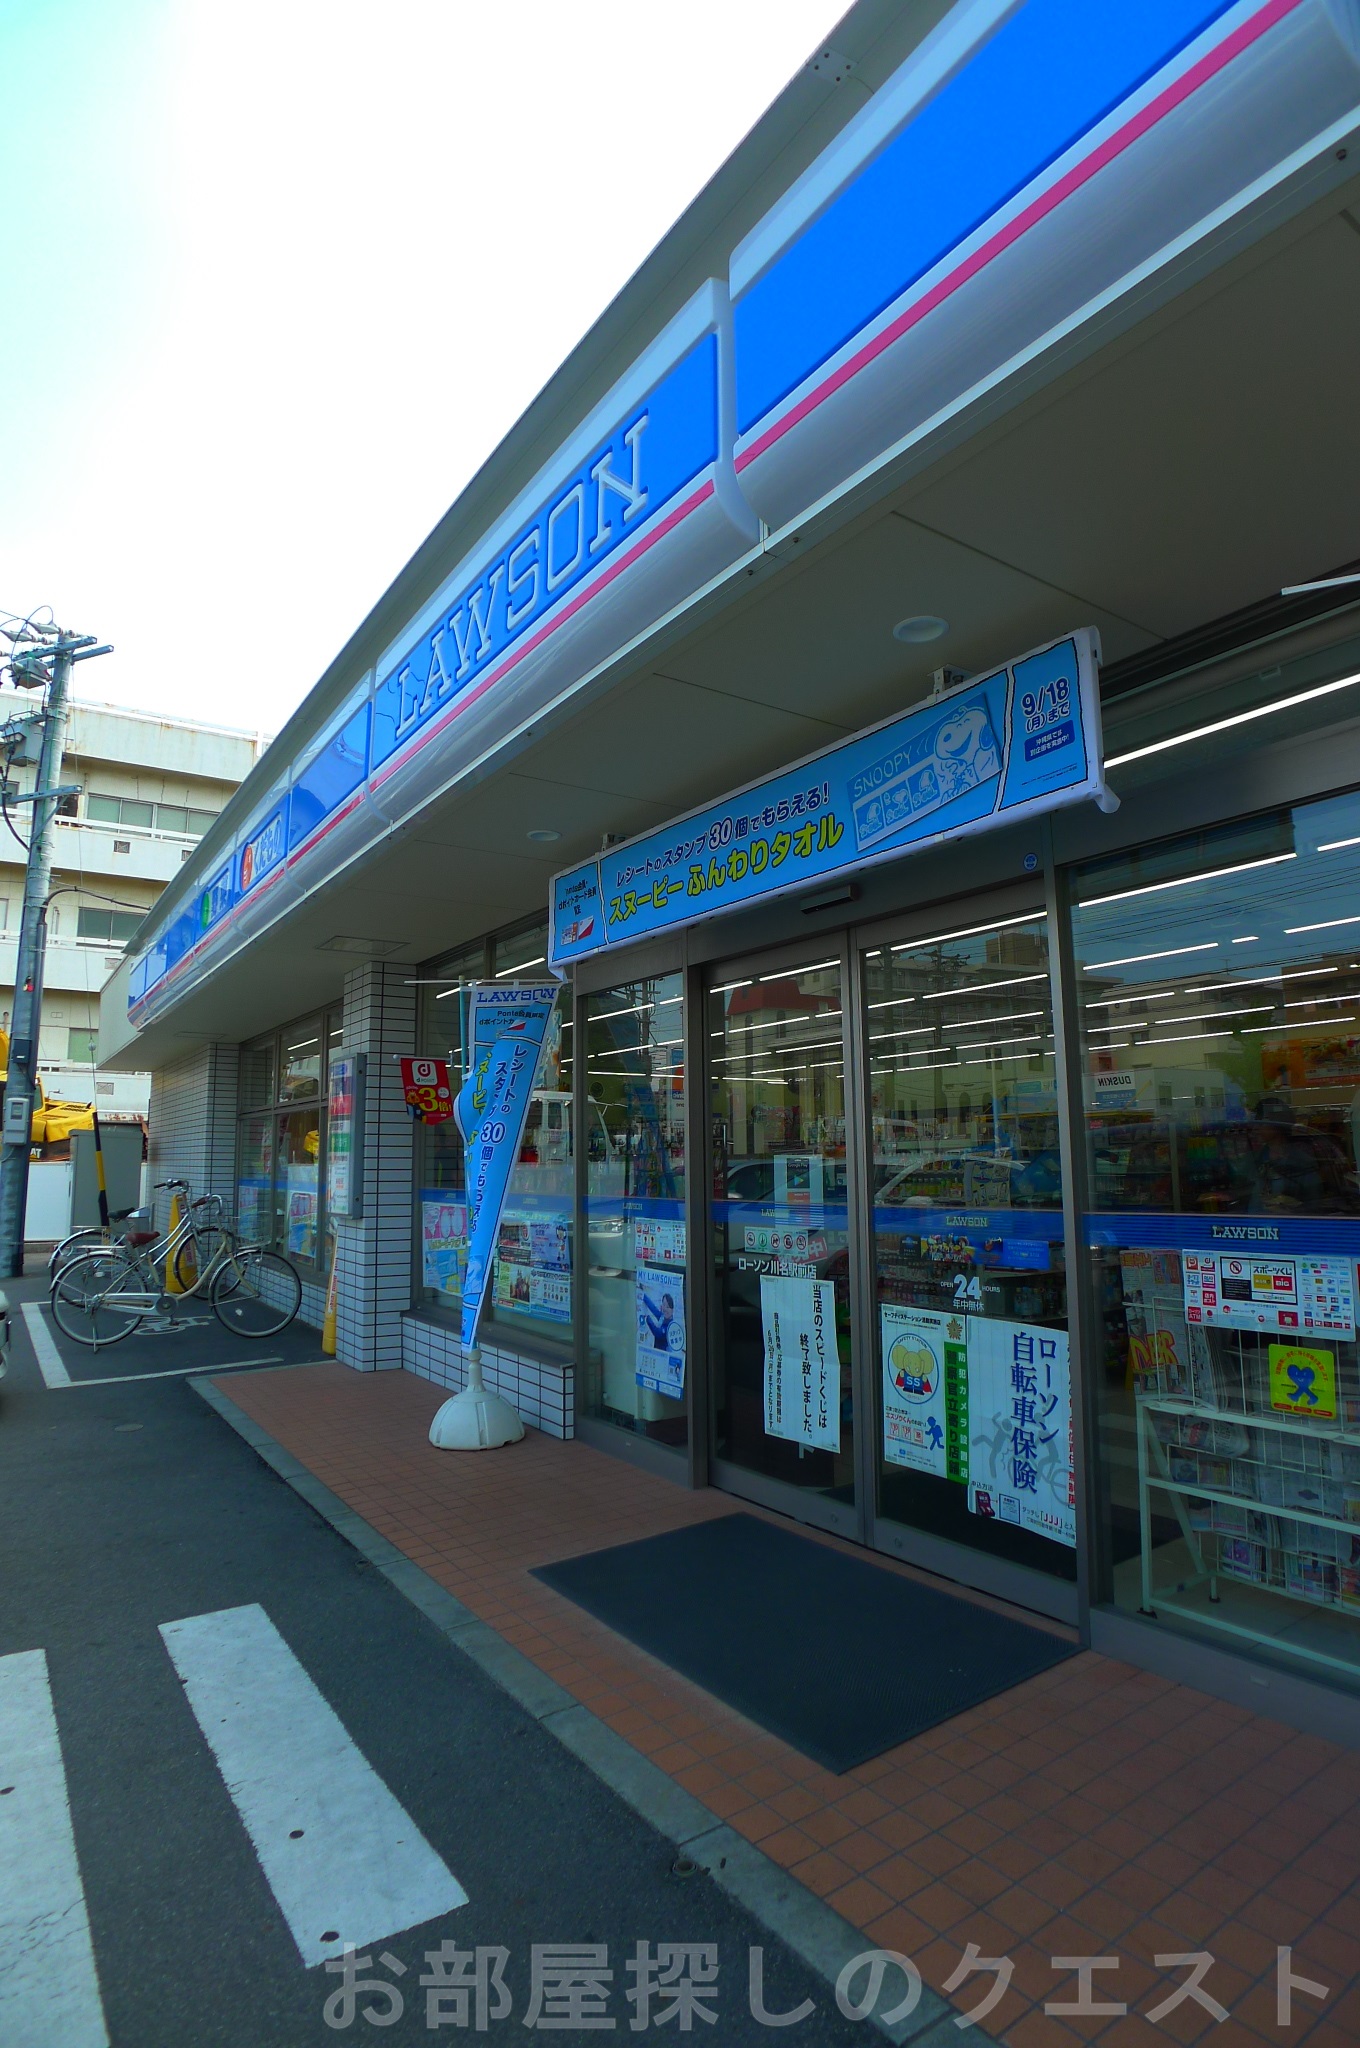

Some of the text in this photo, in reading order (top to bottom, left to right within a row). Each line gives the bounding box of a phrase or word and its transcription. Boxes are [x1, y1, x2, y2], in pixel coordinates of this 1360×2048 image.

[395, 413, 648, 738] LAWSON
[1022, 678, 1069, 716] 9/18
[1027, 702, 1070, 732] (月)まで
[855, 746, 911, 798] SNOOPY
[616, 782, 829, 887] レシートのスタンプ30個でもらえる!
[477, 988, 556, 1002] LAWSON
[30, 1147, 42, 1159] AT
[945, 1216, 988, 1227] LAWSON
[1212, 1225, 1279, 1240] LAWSON
[638, 1271, 673, 1285] MY LAWSON
[738, 1257, 817, 1280] ローソン川名駅前店
[1253, 1264, 1293, 1276] スポーツくじ
[940, 1273, 1000, 1300] OPEN 24 HOURS
[953, 1299, 984, 1312] 年中無休
[813, 1284, 827, 1428] 当店のスピードくじは
[799, 1333, 813, 1440] 終了致しました。
[906, 1376, 921, 1387] SS
[1038, 1337, 1060, 1444] ローソン
[1011, 1331, 1037, 1494] 自転車保険
